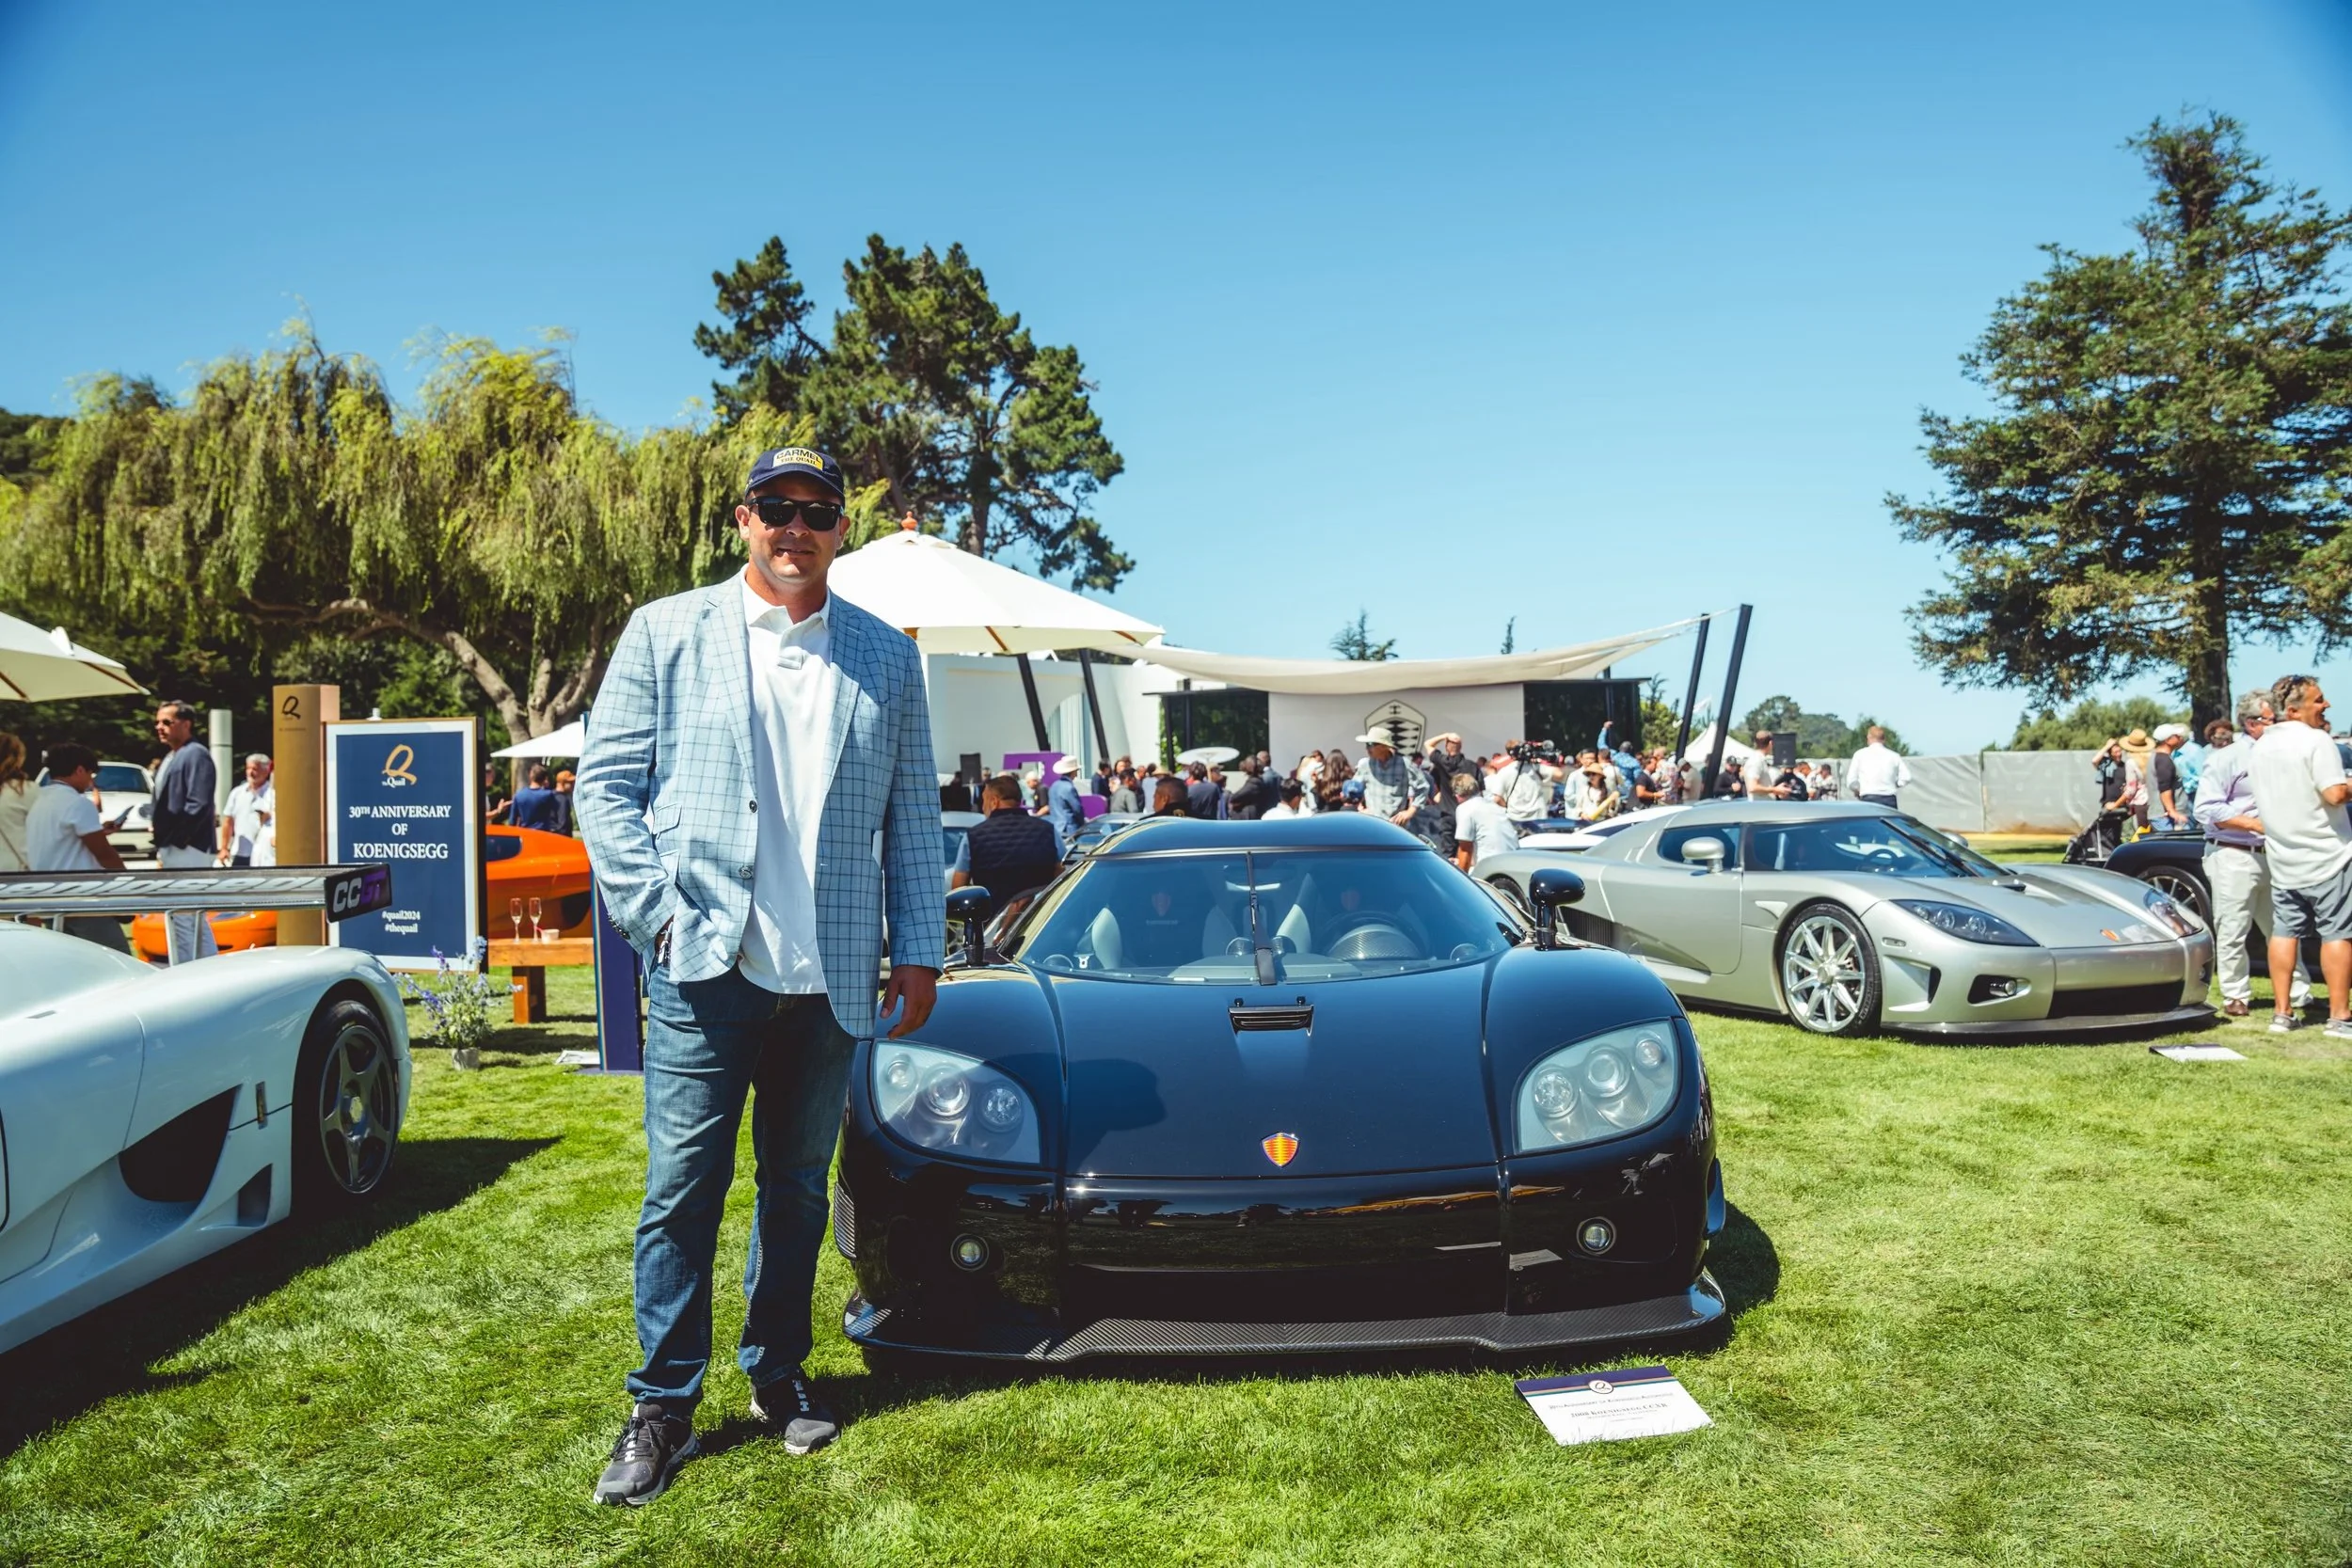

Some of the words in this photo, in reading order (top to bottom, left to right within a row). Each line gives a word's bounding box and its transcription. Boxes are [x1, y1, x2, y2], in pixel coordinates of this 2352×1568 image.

[776, 449, 821, 464] CARMEL
[795, 457, 817, 466] QUAIL
[387, 776, 405, 788] Quail
[371, 805, 452, 818] ANNIVERSARY
[391, 822, 408, 835] OF
[353, 843, 449, 859] KOENIGSEGG
[333, 870, 387, 912] CCGT
[382, 910, 421, 922] #quail2024
[385, 923, 418, 935] #thequail
